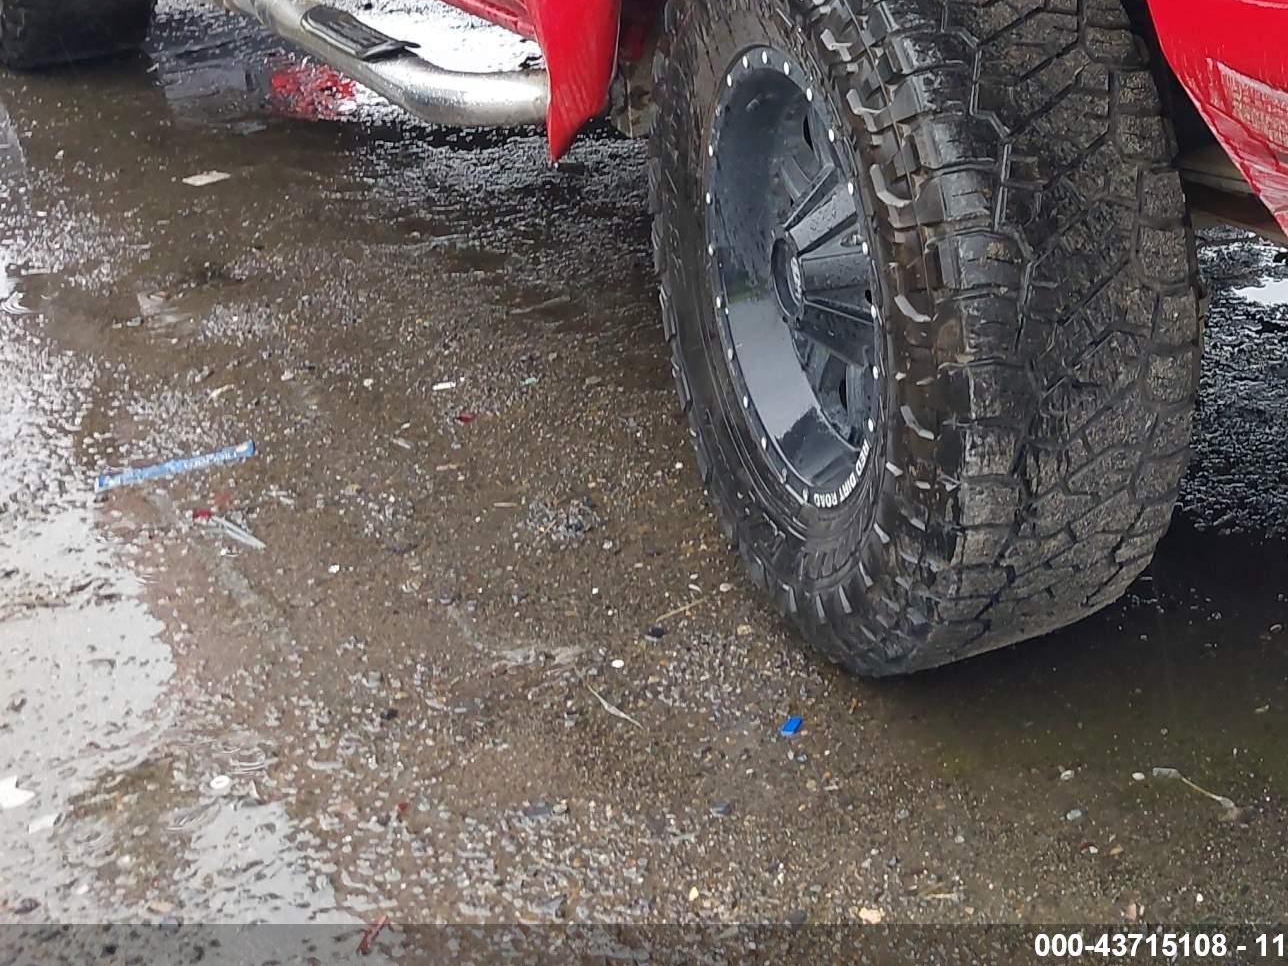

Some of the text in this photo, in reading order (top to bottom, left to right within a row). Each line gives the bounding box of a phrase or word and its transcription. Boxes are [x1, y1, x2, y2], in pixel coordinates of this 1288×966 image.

[813, 438, 869, 508] RED DIRT ROAD
